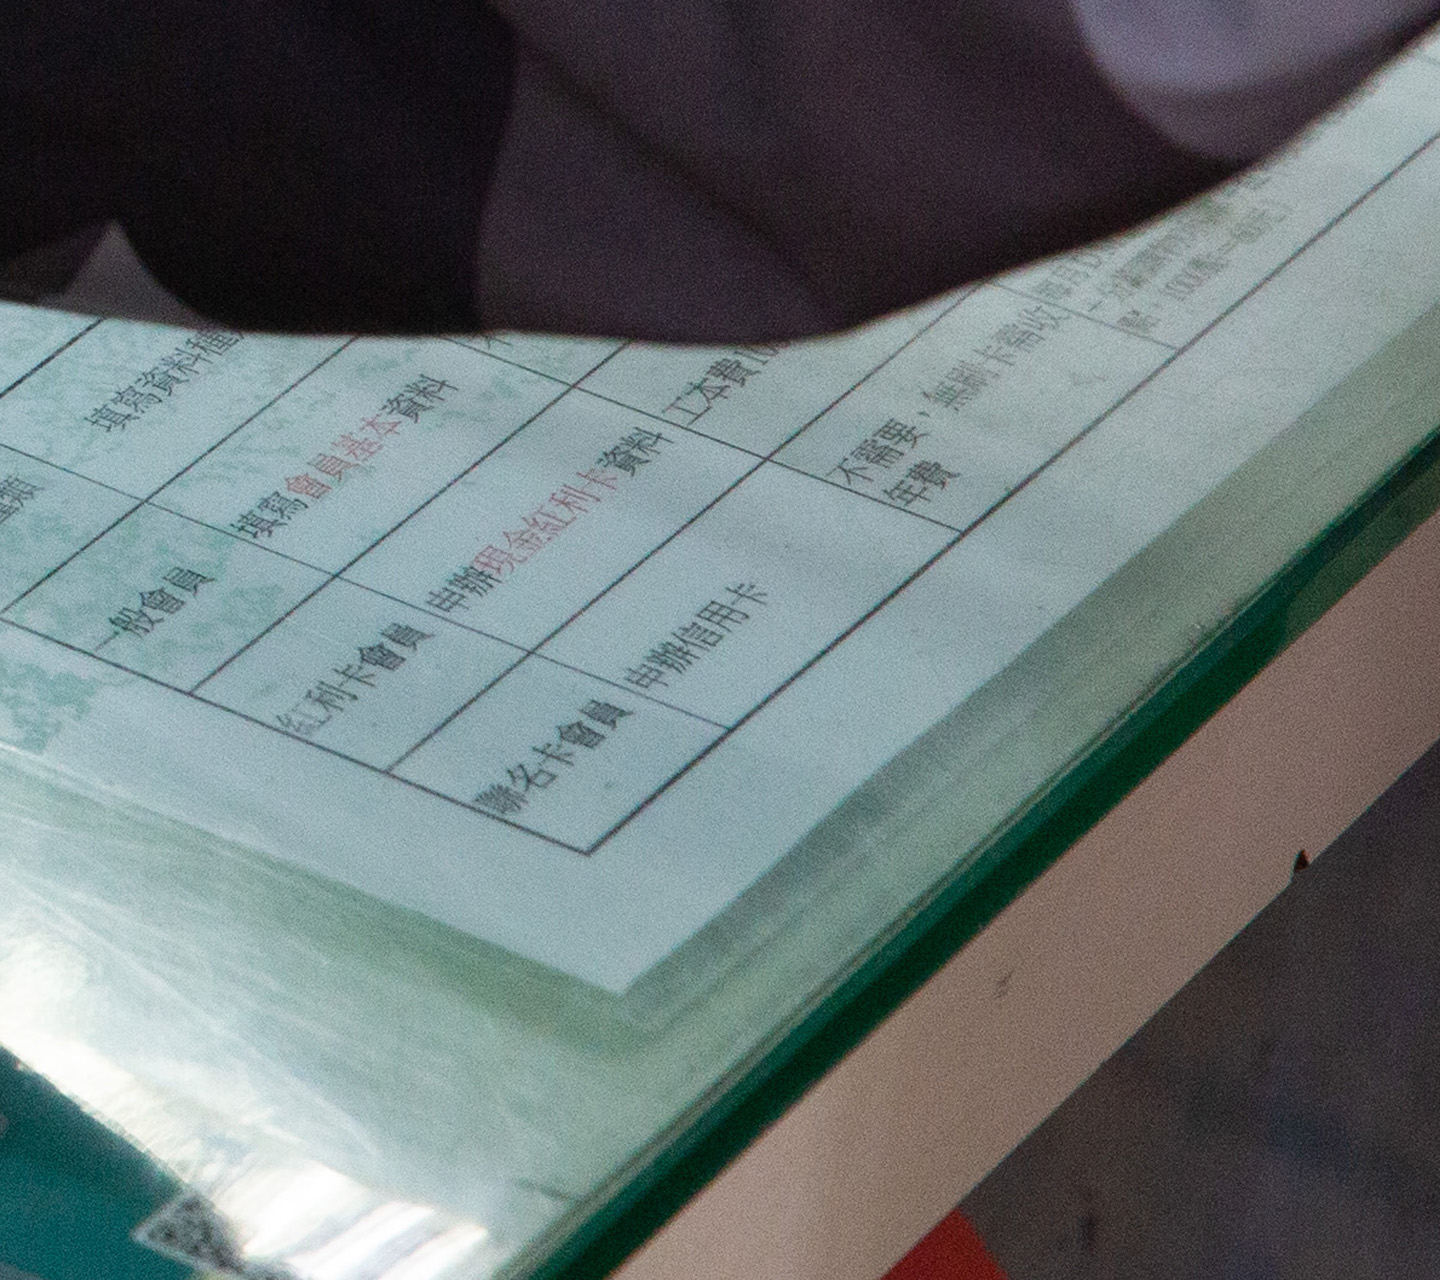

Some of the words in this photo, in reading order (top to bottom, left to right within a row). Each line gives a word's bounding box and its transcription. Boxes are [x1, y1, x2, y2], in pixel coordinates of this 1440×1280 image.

[80, 320, 244, 436] 填寫資料種
[228, 370, 461, 543] 填寫會員基本資料
[881, 459, 963, 510] 年費
[92, 565, 217, 653] 一般會員
[623, 578, 770, 696] 申辦信用卡
